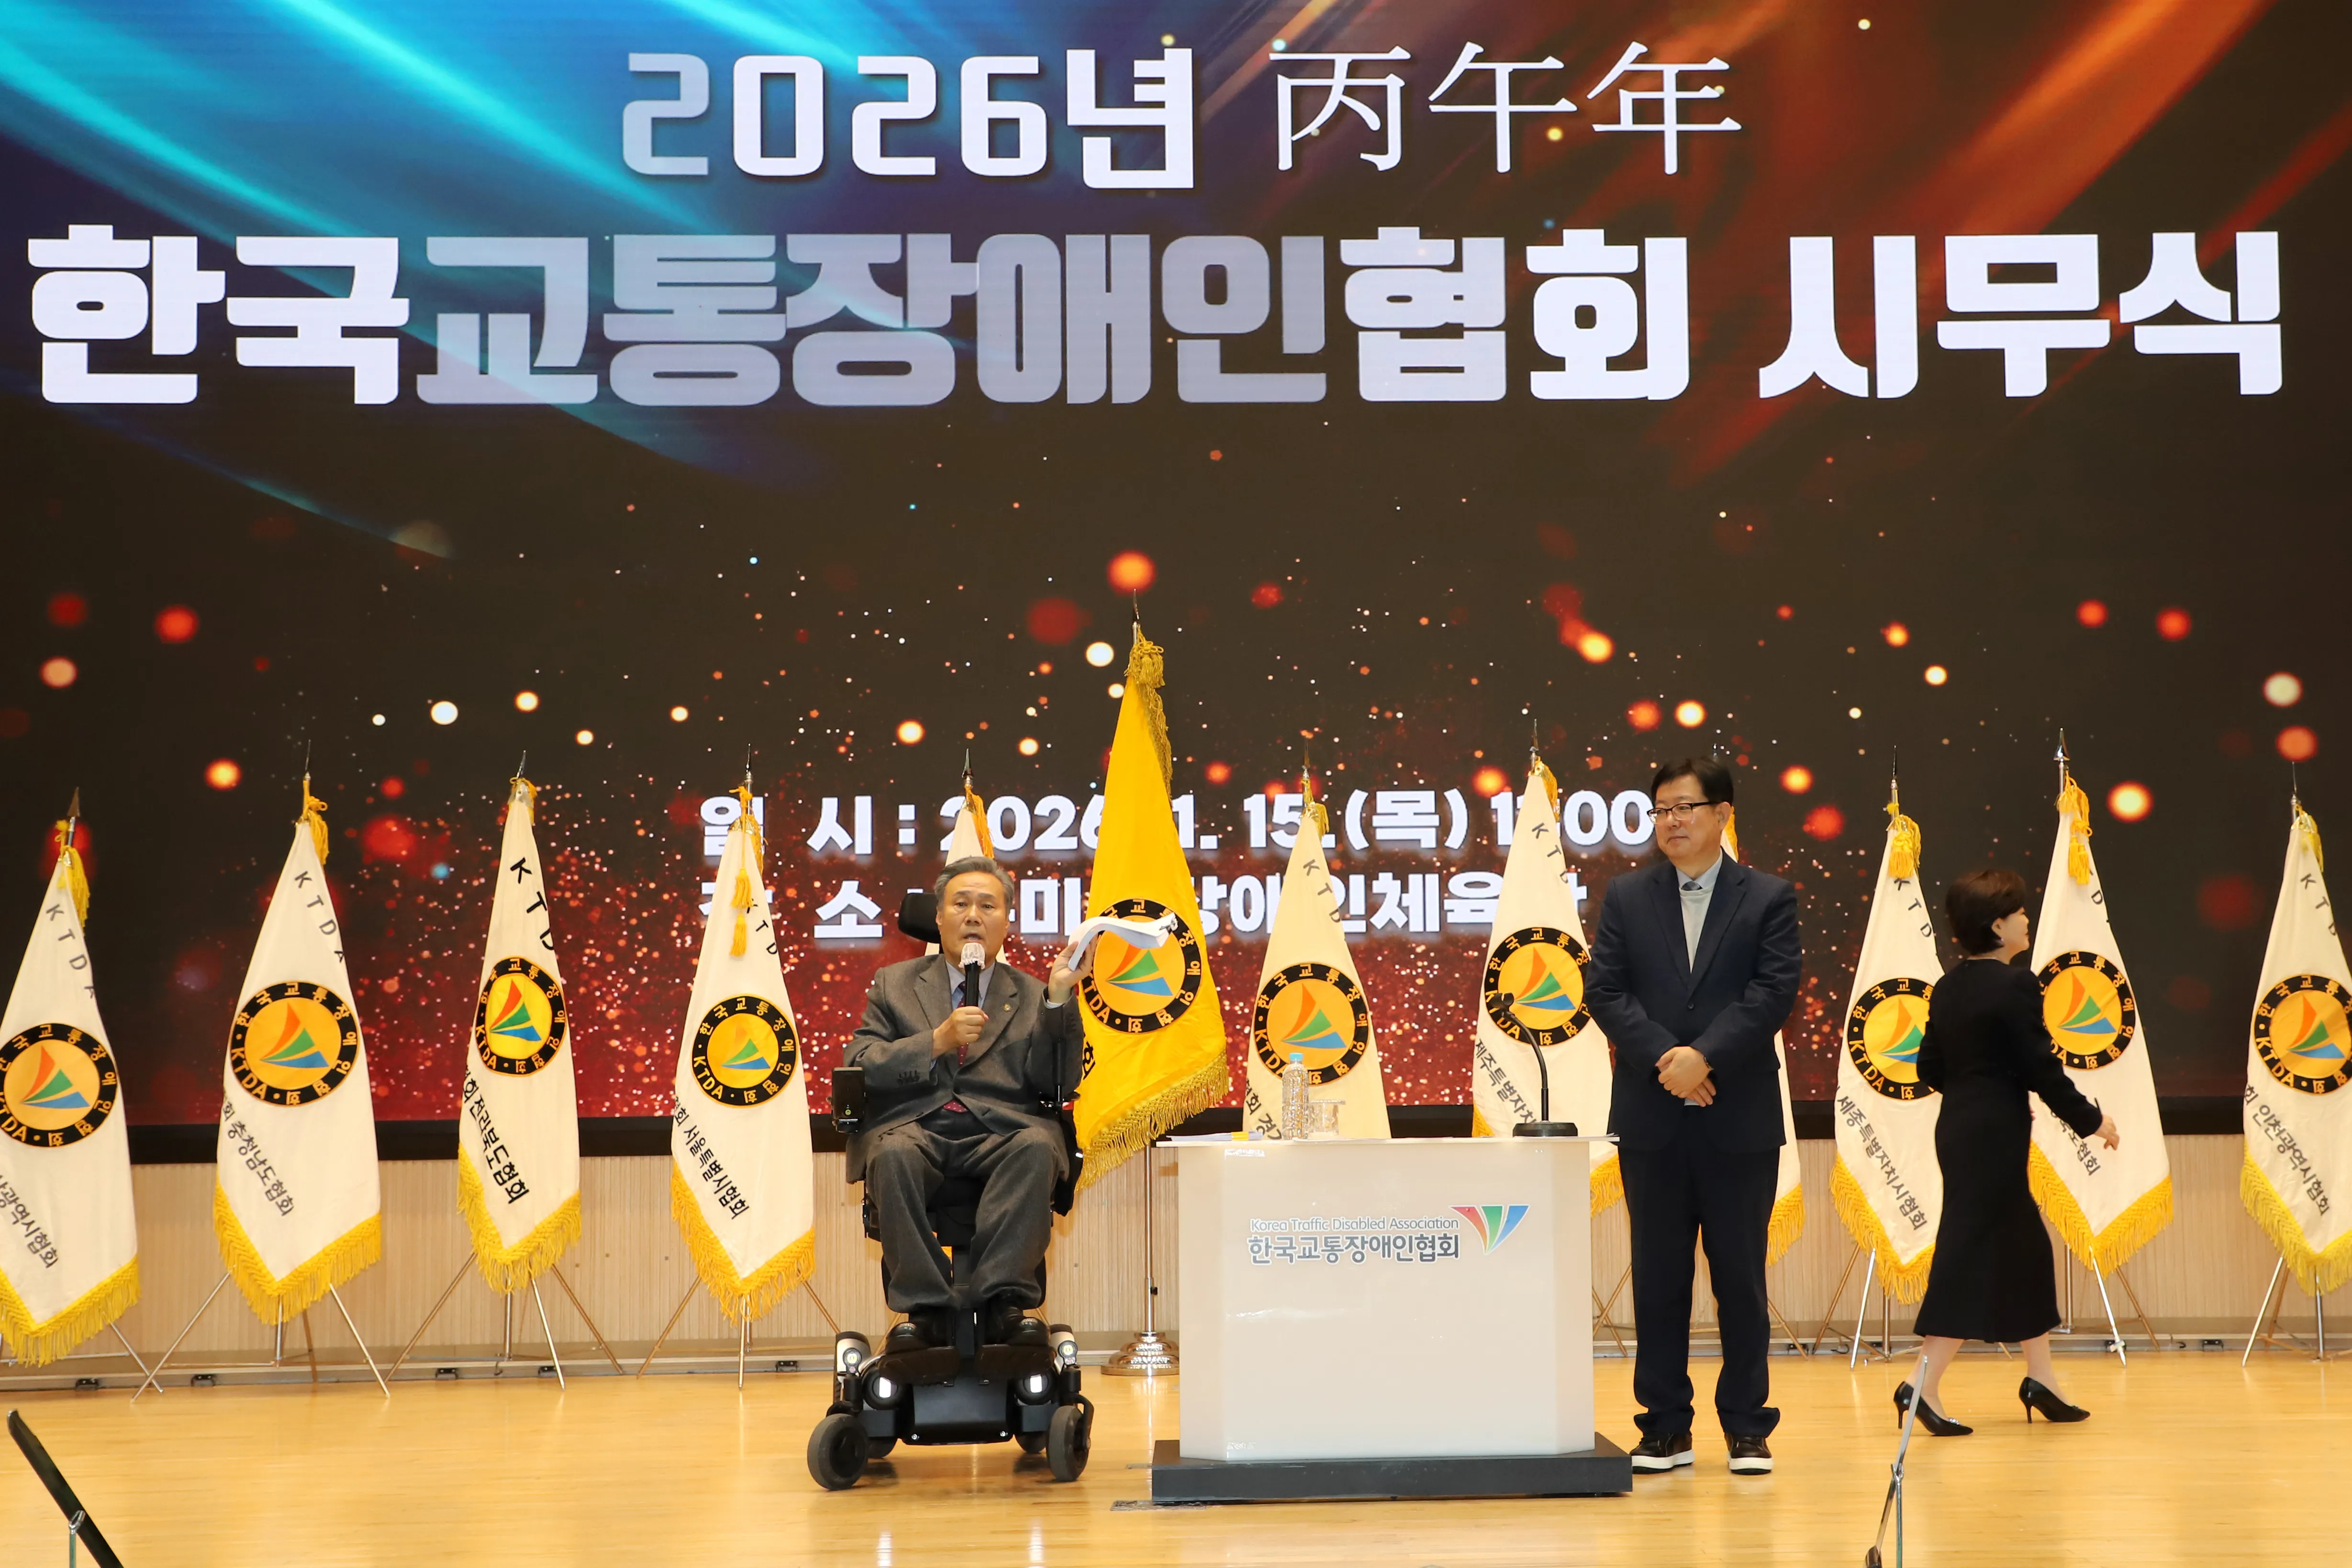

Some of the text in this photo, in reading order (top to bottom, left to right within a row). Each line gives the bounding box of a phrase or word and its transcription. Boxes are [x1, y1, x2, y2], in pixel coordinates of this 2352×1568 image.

[622, 41, 1742, 189] 2026년 丙午年
[27, 224, 2283, 407] 한국교통장애인협회 시무식
[806, 795, 872, 855] 시
[814, 880, 883, 938] 소
[230, 1048, 268, 1100] KTDA
[236, 981, 357, 1105] 한국교통장애인협회
[693, 1055, 724, 1100] KTDA
[699, 997, 795, 1104] 한국교통장애인협회
[1849, 1039, 1885, 1092] KTDA
[2255, 1036, 2296, 1088] KTDA
[227, 1121, 295, 1217] 충청남도협회
[469, 1095, 530, 1204] 전라북도협회
[683, 1125, 750, 1220] 서울특별시협회
[1837, 1095, 1928, 1231] 세종특별자치시협회
[2252, 1104, 2330, 1216] 인천광역시협회
[1248, 1233, 1459, 1264] 한국교통장애인협회
[1251, 1216, 1459, 1232] Korea Traffic Disabled Association
